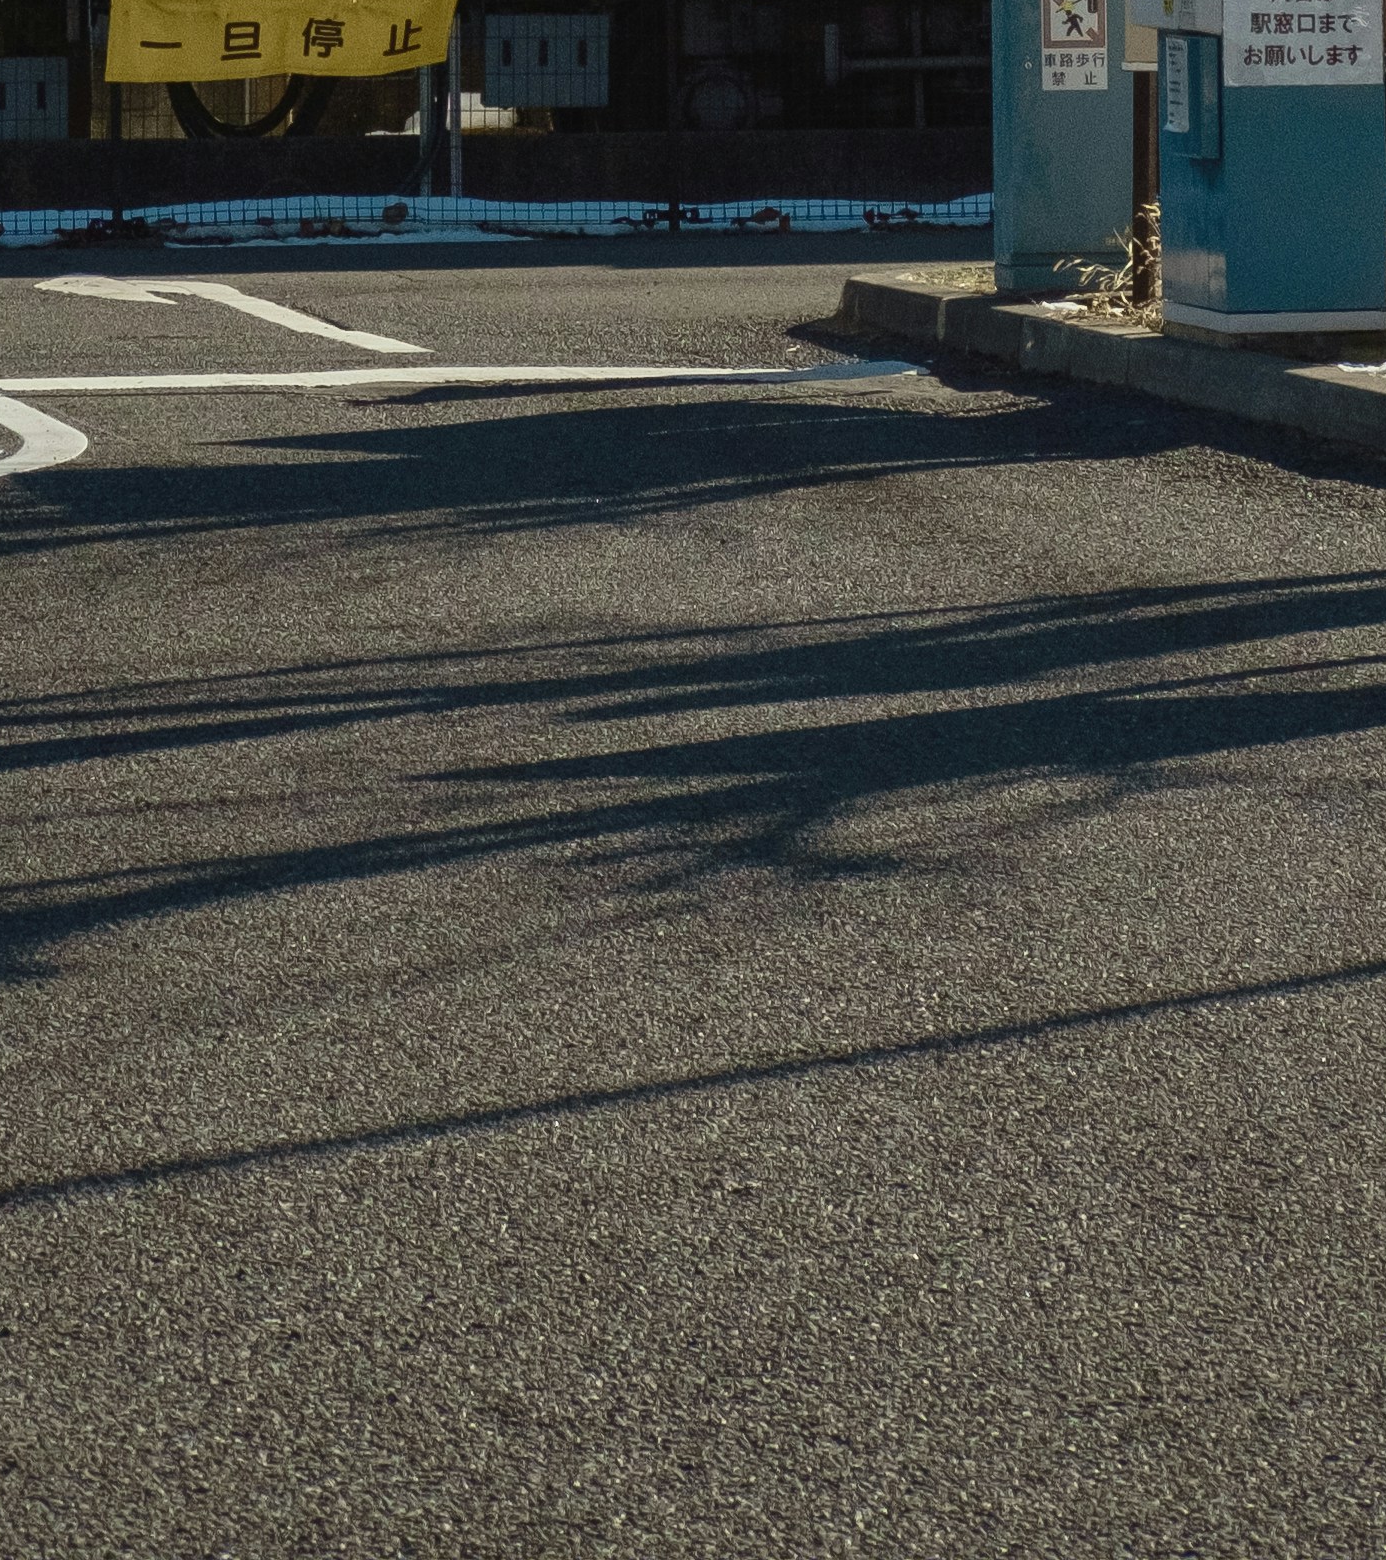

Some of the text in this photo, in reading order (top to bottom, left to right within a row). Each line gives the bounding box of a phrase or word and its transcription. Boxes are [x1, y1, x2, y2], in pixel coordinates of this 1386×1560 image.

[1250, 12, 1356, 34] 駅窓口まで
[140, 17, 423, 61] 一旦停止
[1044, 53, 1105, 68] 車路歩行
[1243, 44, 1363, 67] お願いします
[1051, 71, 1098, 86] 禁止
